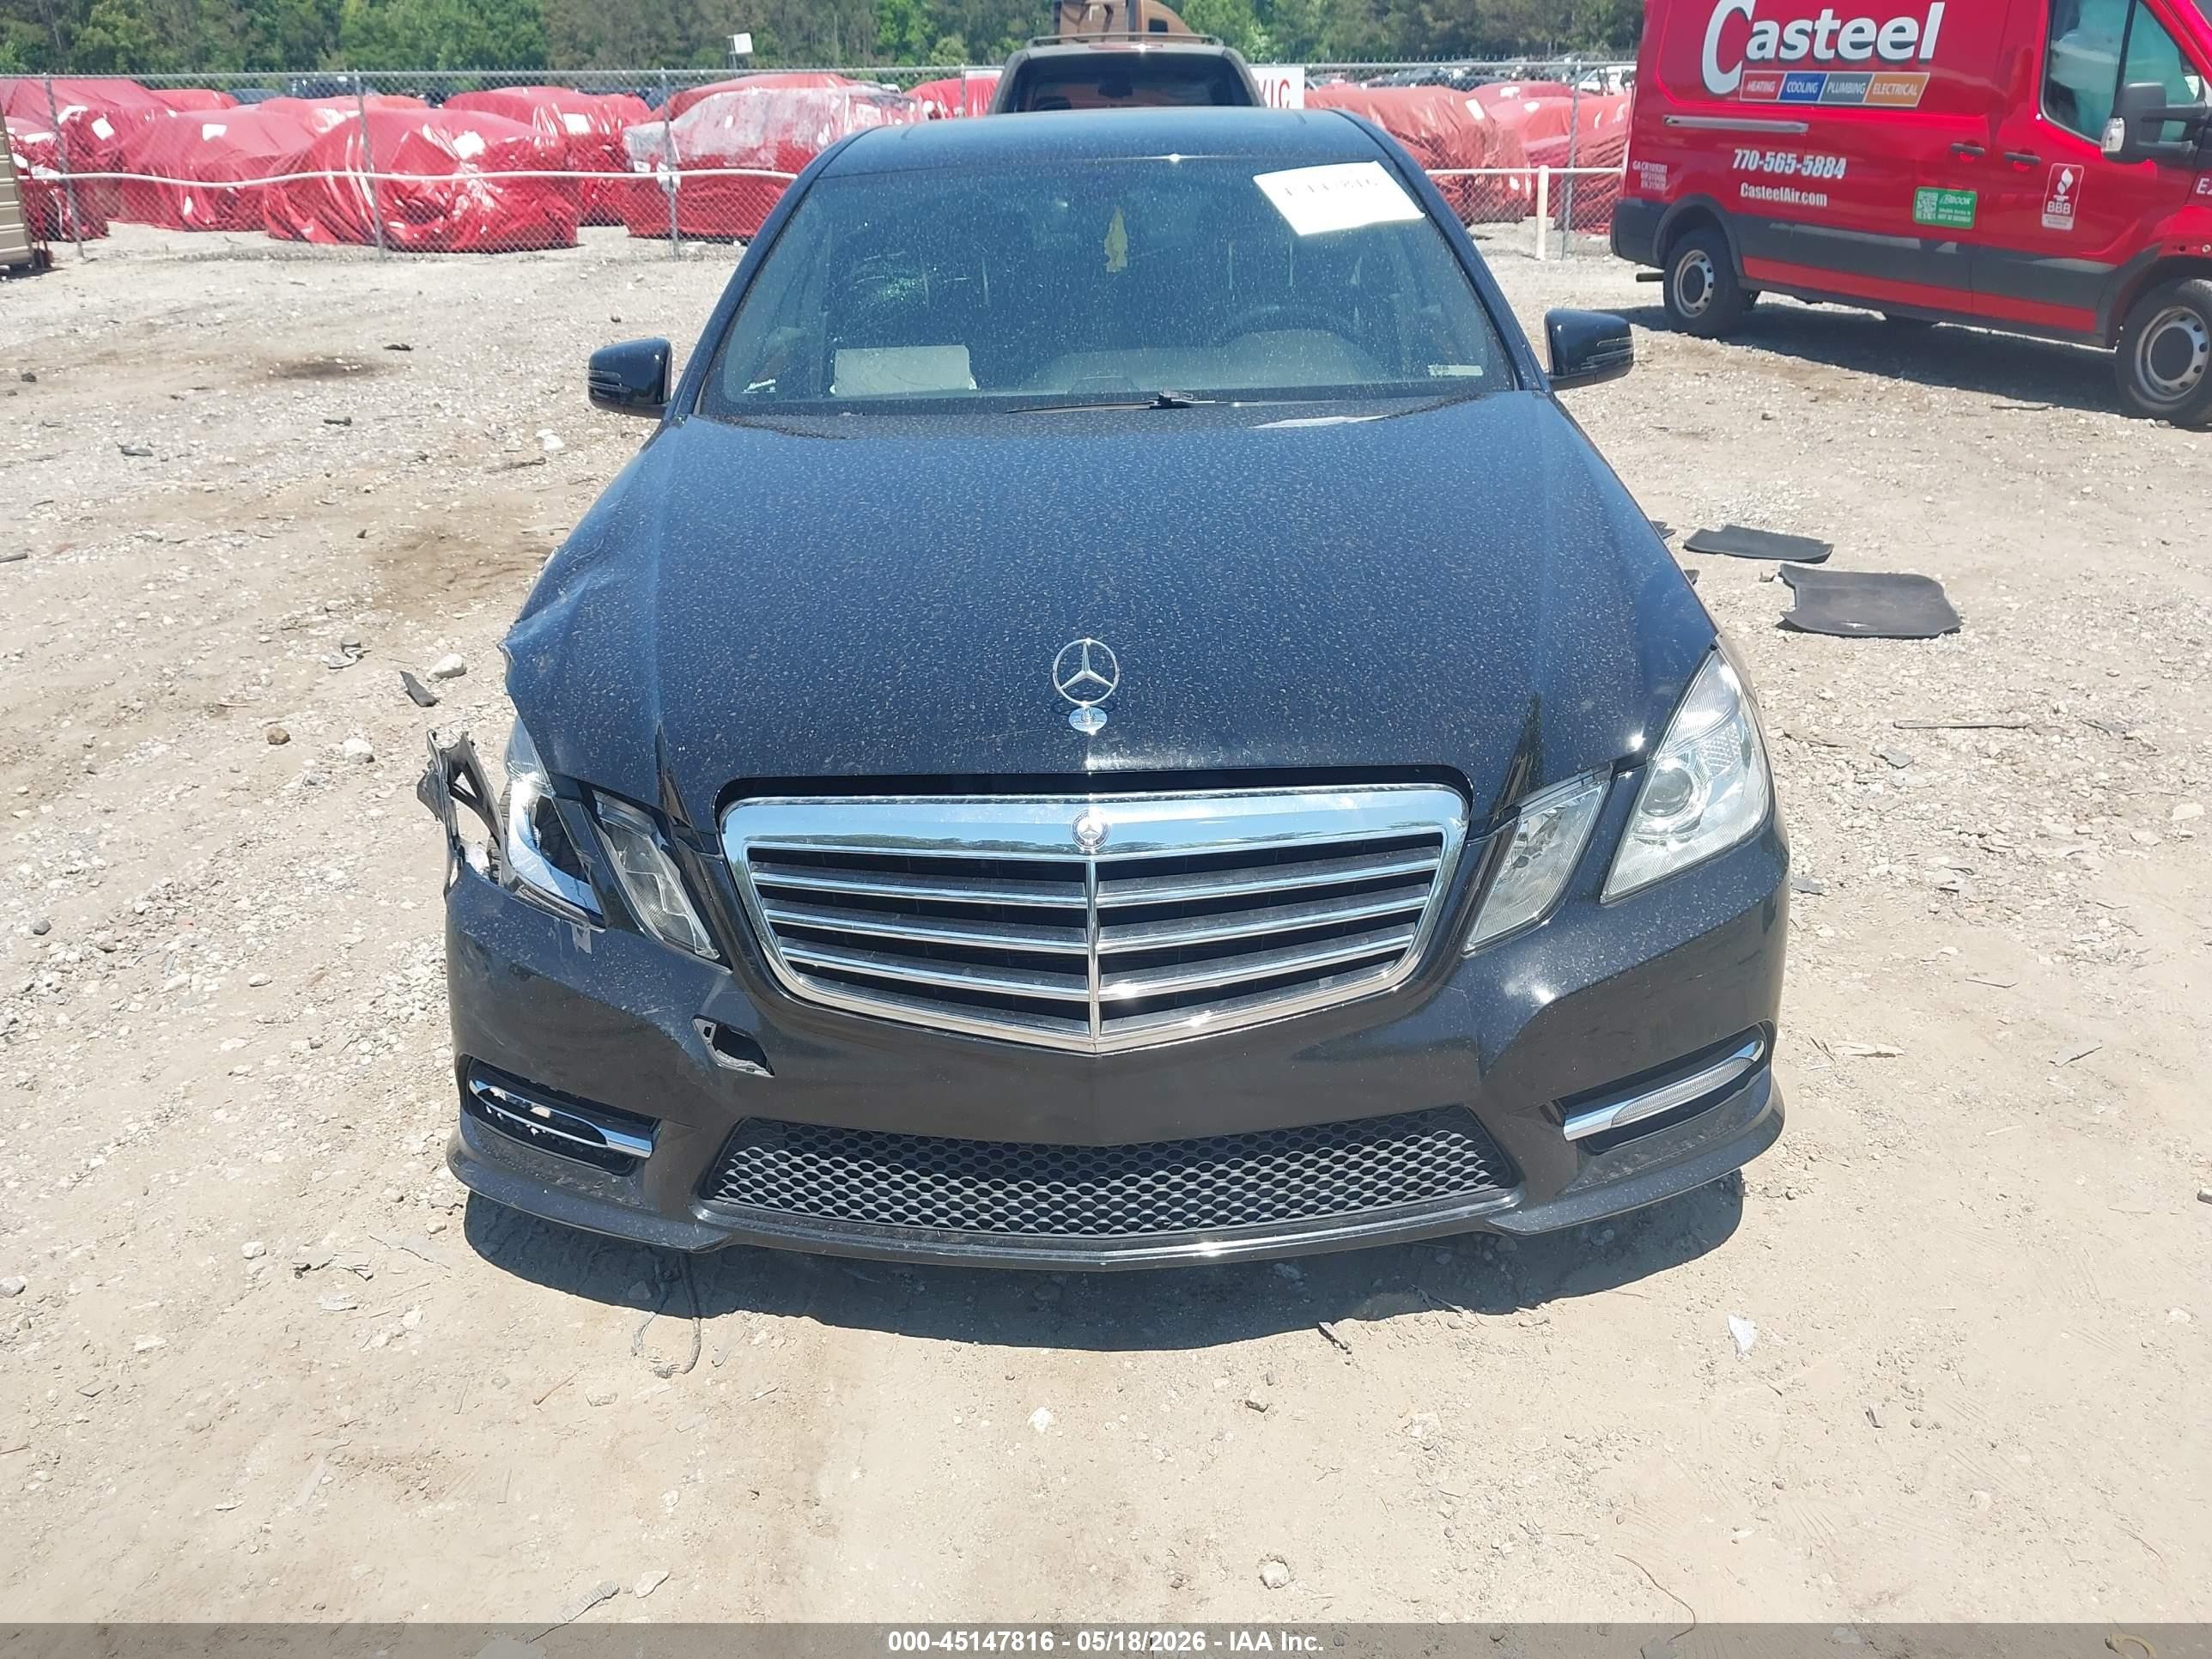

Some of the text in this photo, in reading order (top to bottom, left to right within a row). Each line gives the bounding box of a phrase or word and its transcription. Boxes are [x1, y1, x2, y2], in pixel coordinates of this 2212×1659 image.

[1702, 0, 1945, 94] Casteel
[1747, 81, 1776, 93] HEATING
[1786, 82, 1819, 94] COOLING
[1827, 82, 1866, 95] PLUMBING
[1872, 83, 1918, 96] ELECTRICAL
[1733, 149, 1846, 179] 770-565-5884
[1740, 182, 1828, 207] CasteelAir.com
[2047, 201, 2071, 214] BBB
